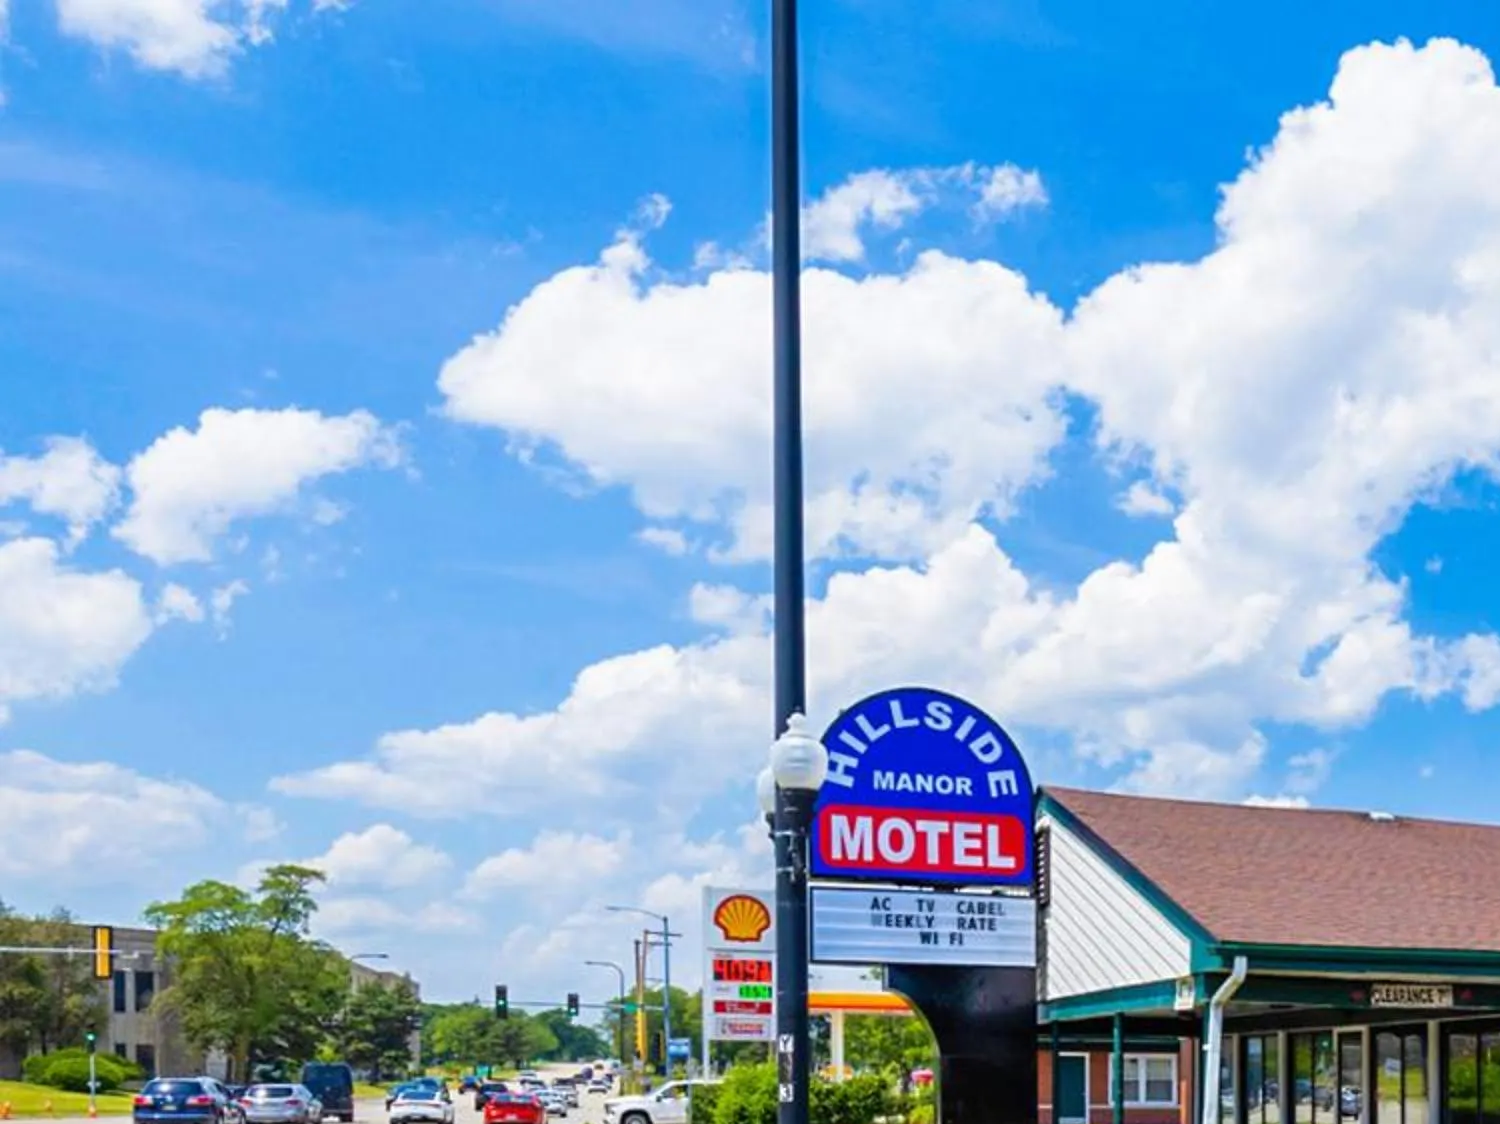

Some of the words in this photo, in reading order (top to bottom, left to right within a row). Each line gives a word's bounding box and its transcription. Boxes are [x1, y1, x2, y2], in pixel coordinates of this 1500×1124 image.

[827, 699, 1019, 798] HILLSIDE
[873, 770, 973, 796] MANOR
[829, 814, 1017, 869] MOTEL
[870, 896, 891, 911] AC
[916, 898, 935, 913] TV
[957, 916, 998, 932] RATE
[920, 931, 938, 945] WI
[949, 932, 964, 945] FI
[1371, 986, 1434, 1004] CLEARANCE
